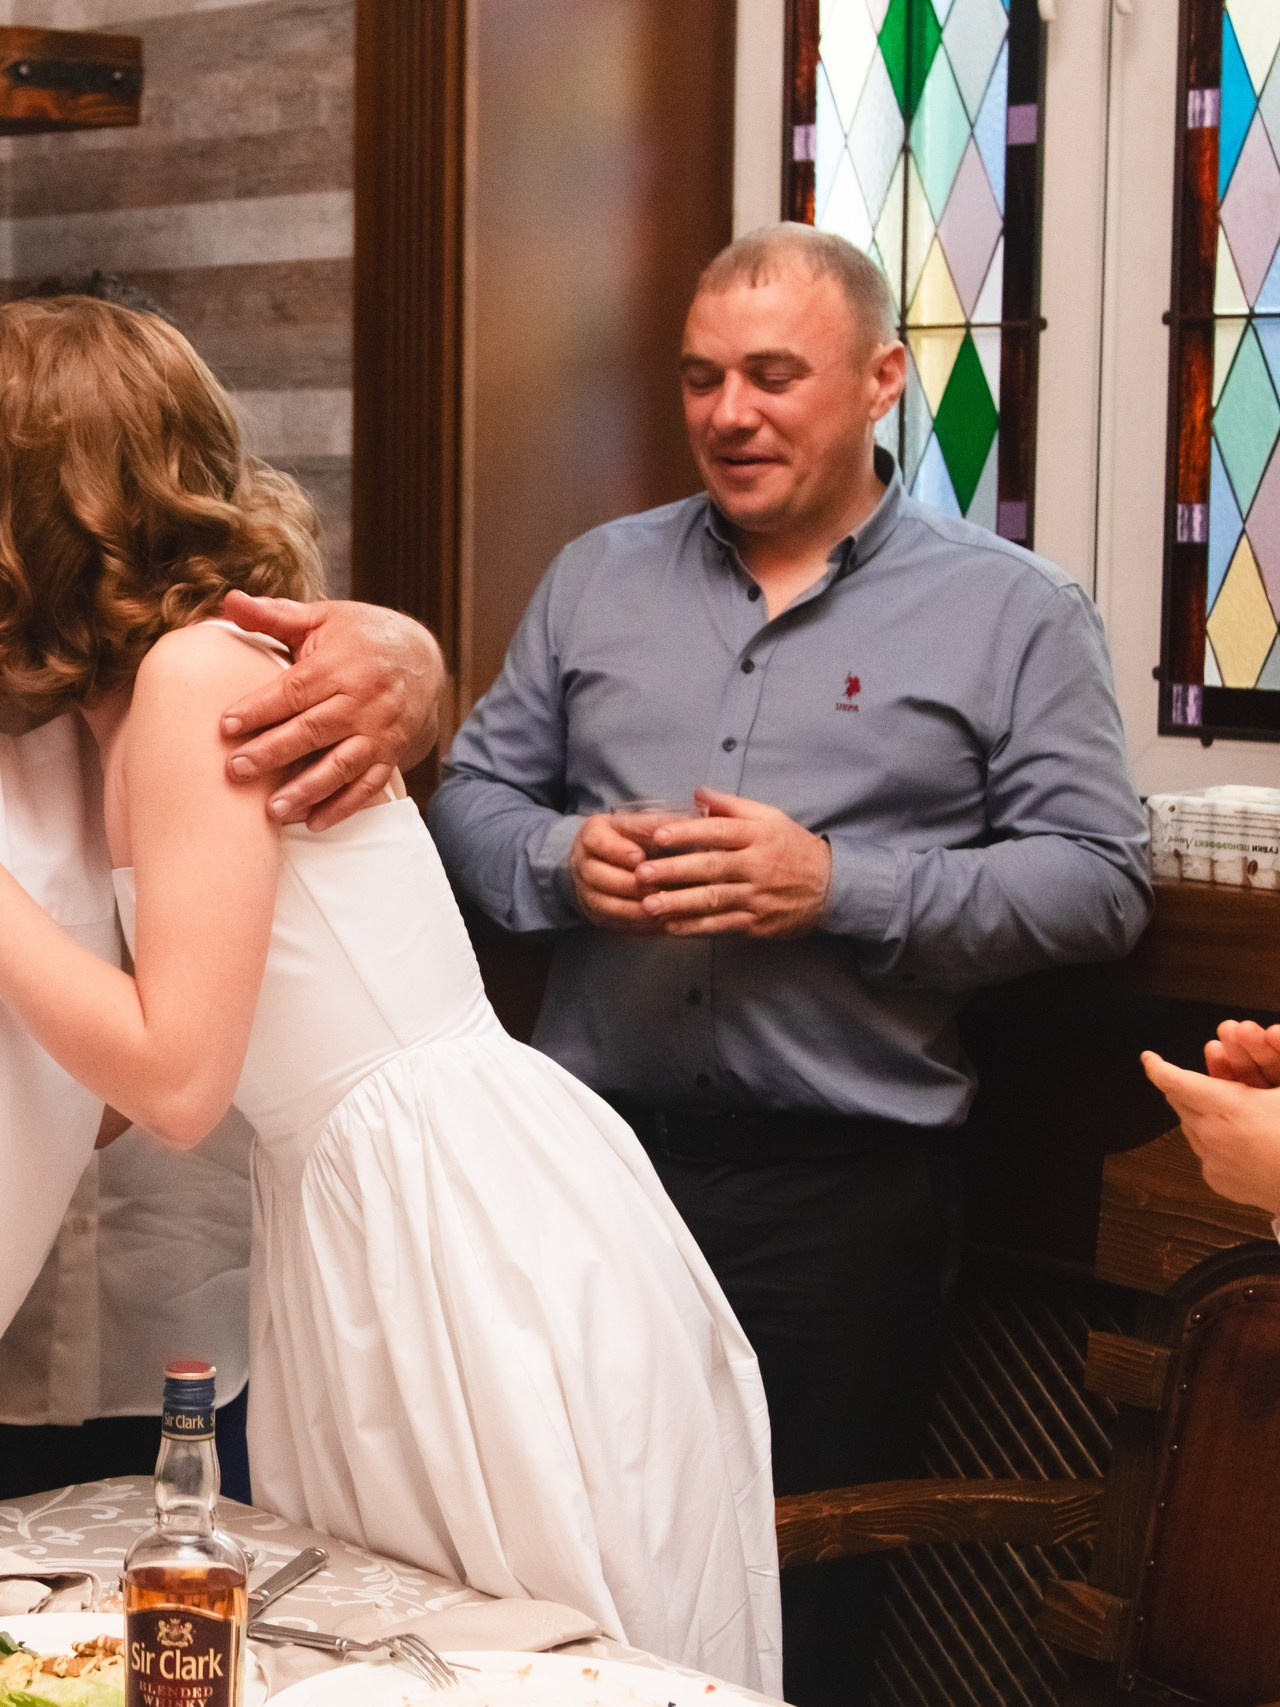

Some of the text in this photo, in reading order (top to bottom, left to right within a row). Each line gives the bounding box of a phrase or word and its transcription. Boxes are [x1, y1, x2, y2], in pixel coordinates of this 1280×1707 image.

[1251, 844, 1279, 855] ГУБКИ
[164, 1412, 175, 1427] Sir
[175, 1414, 206, 1430] Clark
[131, 1641, 224, 1681] Sir Clark
[139, 1680, 214, 1699] BLENDED
